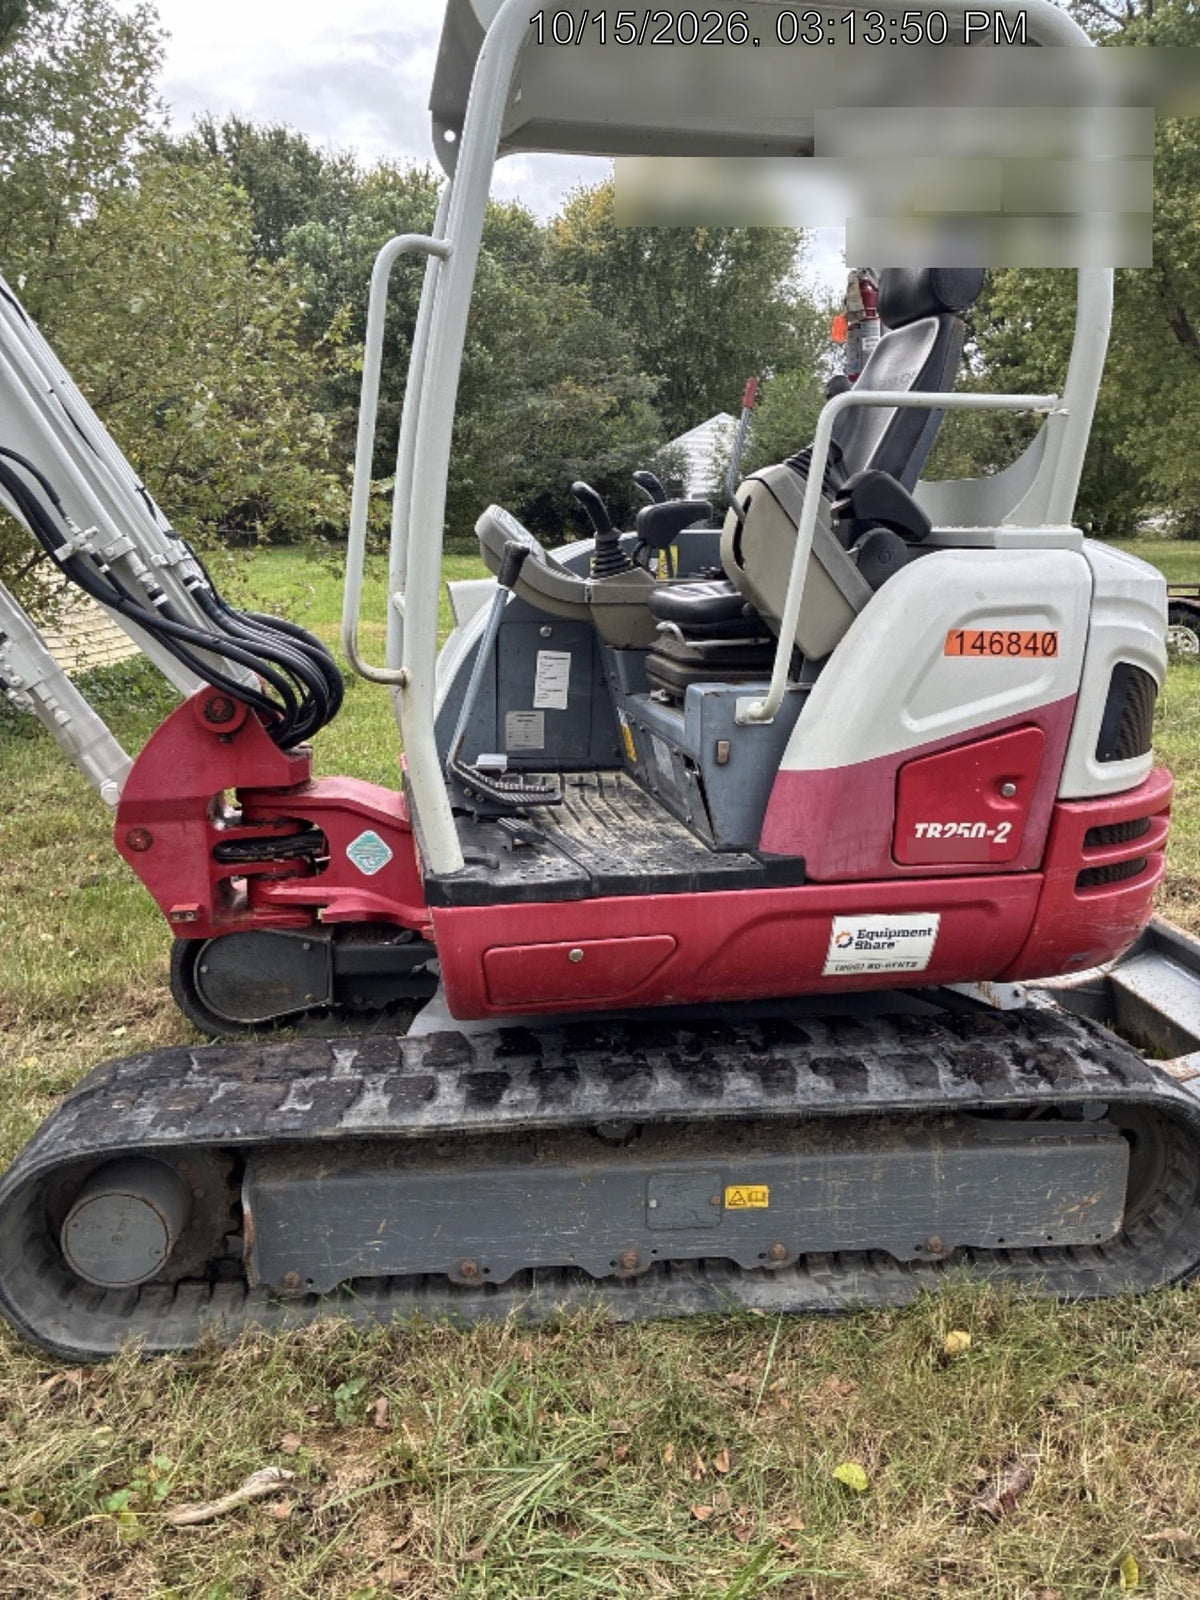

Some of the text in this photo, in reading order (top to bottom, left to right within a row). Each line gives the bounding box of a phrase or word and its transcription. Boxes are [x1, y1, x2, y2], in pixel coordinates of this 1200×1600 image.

[955, 630, 1058, 657] 146840
[856, 927, 933, 941] Equipment
[854, 940, 896, 950] Share
